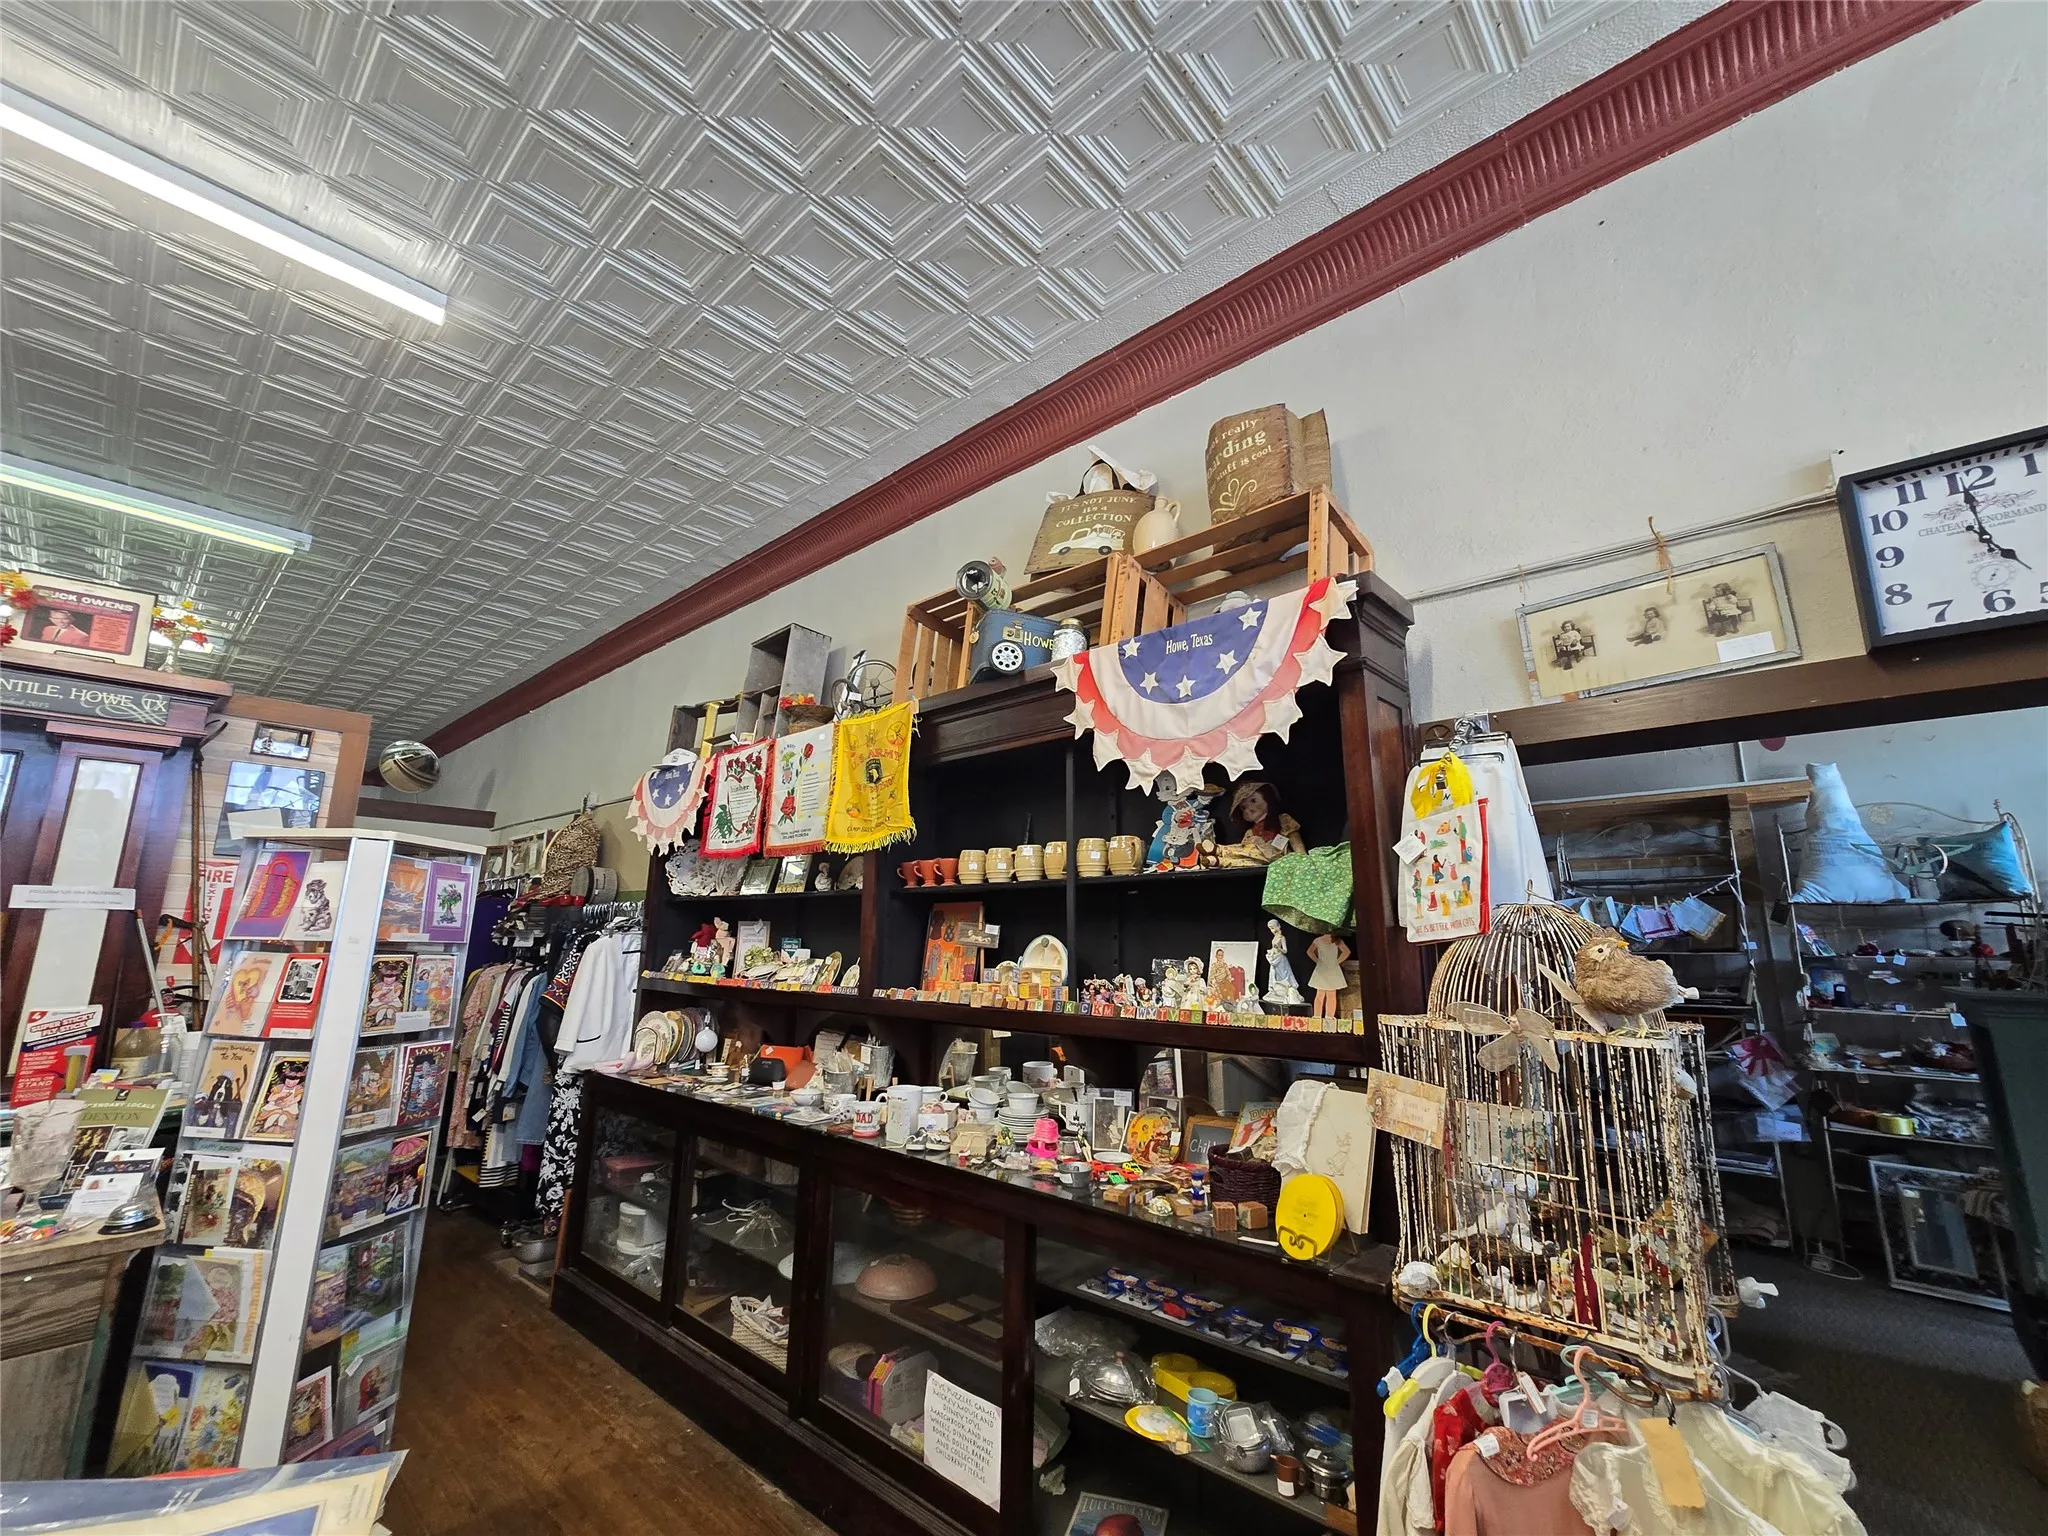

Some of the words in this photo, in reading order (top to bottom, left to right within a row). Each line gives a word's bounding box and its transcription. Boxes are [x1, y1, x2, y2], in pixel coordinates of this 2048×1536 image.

[1221, 418, 1258, 440] really
[1207, 430, 1266, 479] oarding
[1240, 454, 1250, 466] is
[1251, 444, 1272, 460] cool
[2021, 453, 2042, 477] 1
[1943, 465, 1996, 496] 12
[1082, 497, 1106, 507] NOT
[1107, 496, 1137, 504] JUNK
[1894, 480, 1928, 506] 11
[1055, 513, 1132, 528] COLLECTION
[1868, 509, 1909, 536] 10
[1875, 546, 1905, 569] 9
[81, 596, 134, 612] OWENS
[1884, 583, 1913, 606] 8
[1983, 589, 2016, 613] 6
[1926, 599, 1954, 624] 7
[1166, 638, 1189, 655] Howe,
[1191, 633, 1213, 648] Texas
[198, 869, 234, 884] FIRE
[60, 1020, 89, 1034] STICK
[62, 1011, 96, 1026] STICKY
[220, 1052, 229, 1060] To
[230, 1052, 242, 1061] You
[230, 1045, 256, 1055] Birthday
[18, 1080, 52, 1089] STAND
[82, 1111, 142, 1121] DENTON
[855, 1112, 874, 1124] DAD
[932, 1389, 956, 1406] MICKEY
[957, 1403, 979, 1418] MOUSE
[980, 1416, 994, 1428] AND
[974, 1402, 996, 1420] GAMES,
[967, 1426, 981, 1440] AND
[982, 1436, 994, 1448] HOT
[936, 1439, 950, 1450] AND
[950, 1448, 985, 1473] COLLECTIBLE
[1132, 1506, 1160, 1526] LAND
